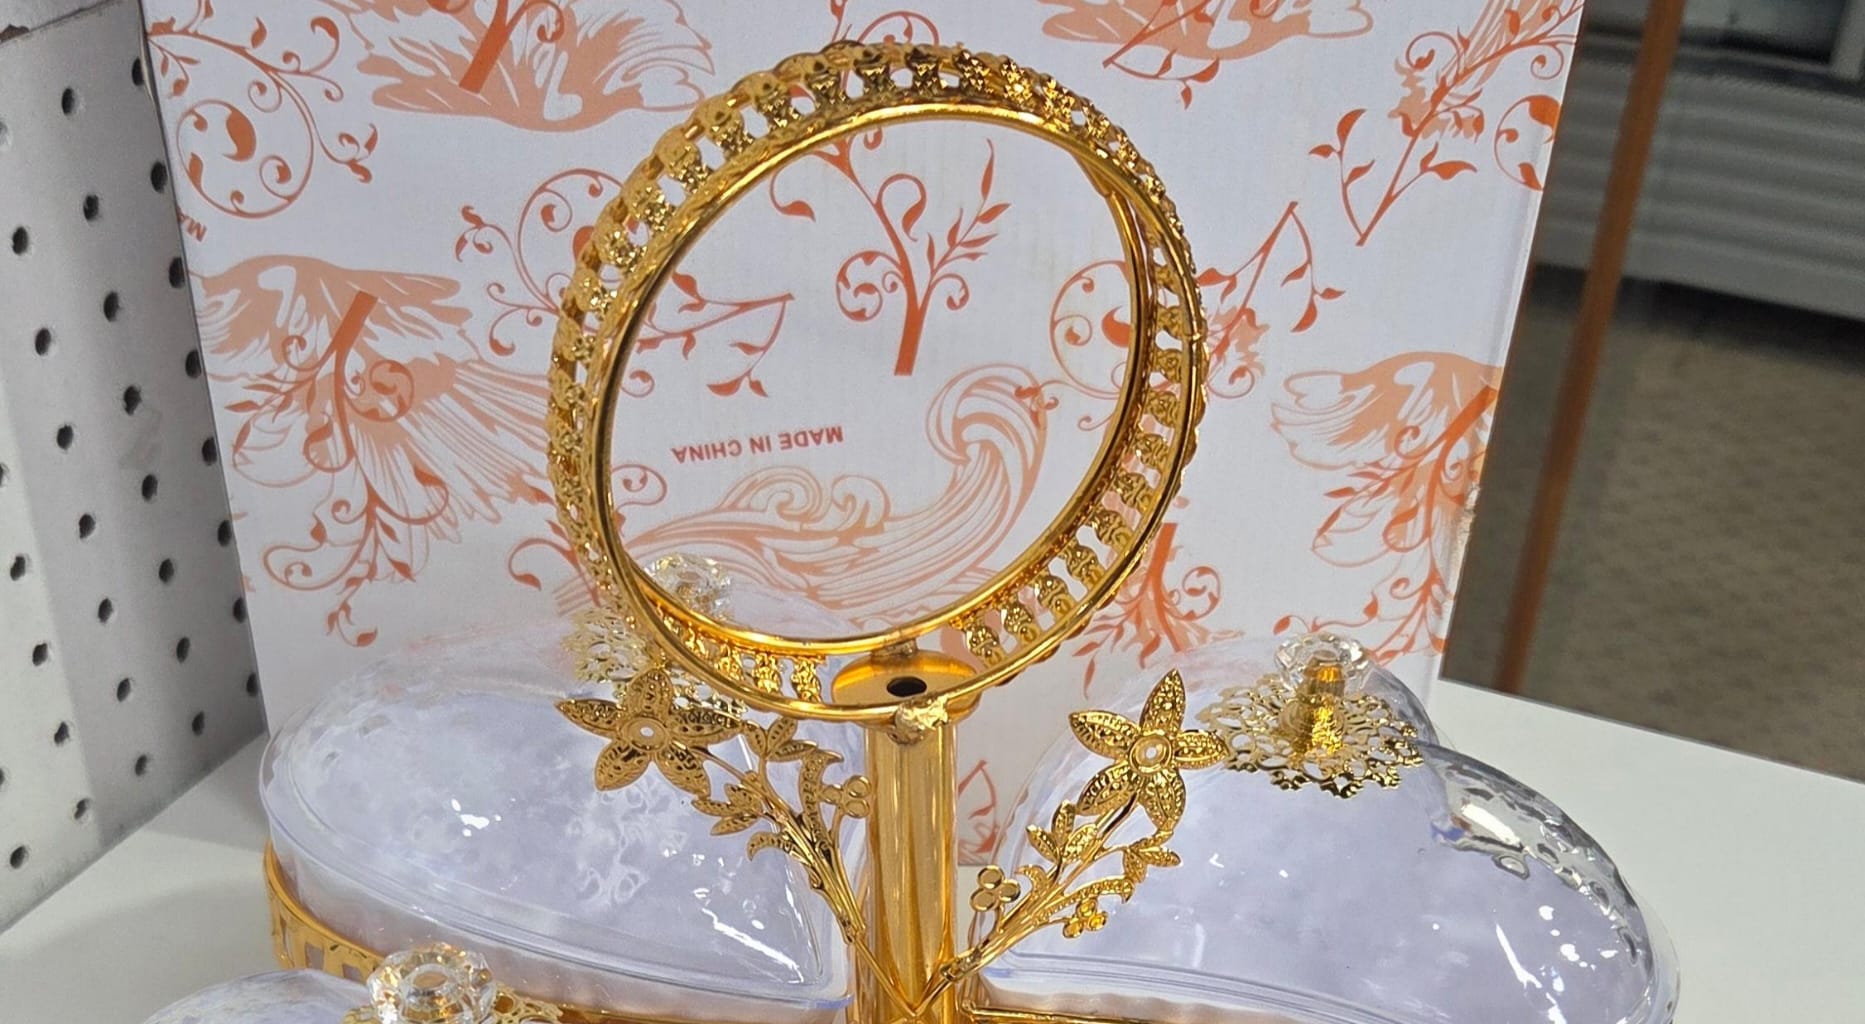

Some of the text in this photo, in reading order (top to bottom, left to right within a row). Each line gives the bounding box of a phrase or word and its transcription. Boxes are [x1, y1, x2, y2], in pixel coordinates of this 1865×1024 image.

[671, 425, 845, 464] MADE IN CHINA
